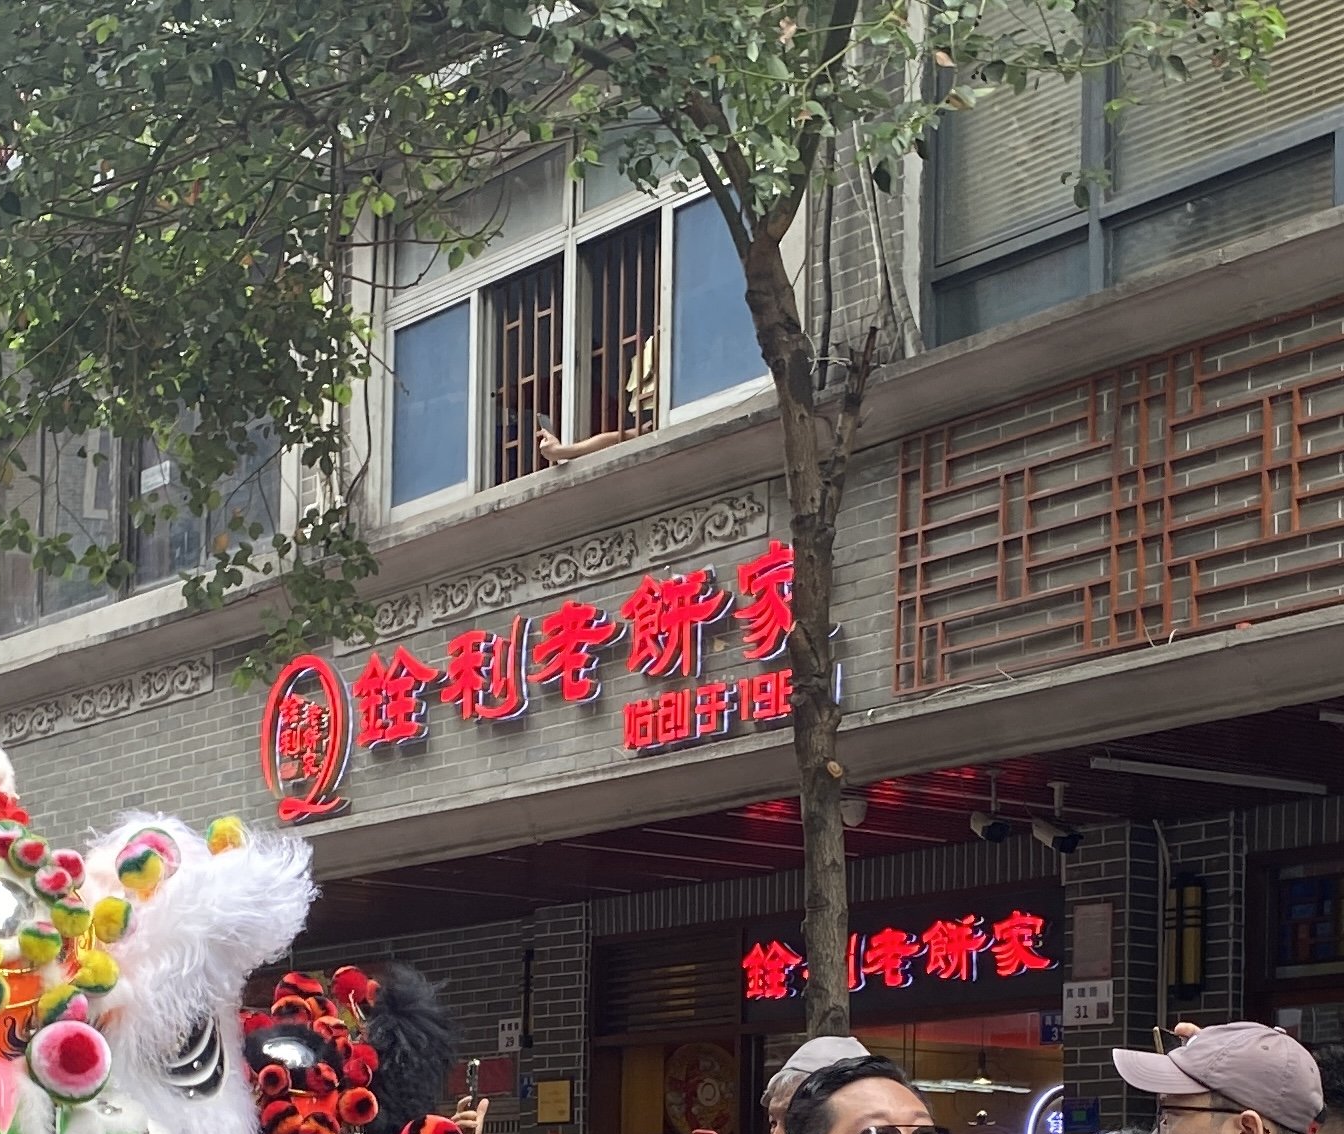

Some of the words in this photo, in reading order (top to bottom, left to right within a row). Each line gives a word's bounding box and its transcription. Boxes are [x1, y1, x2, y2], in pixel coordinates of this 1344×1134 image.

[742, 910, 1051, 999] 銓老餅家
[1074, 1005, 1089, 1019] 31
